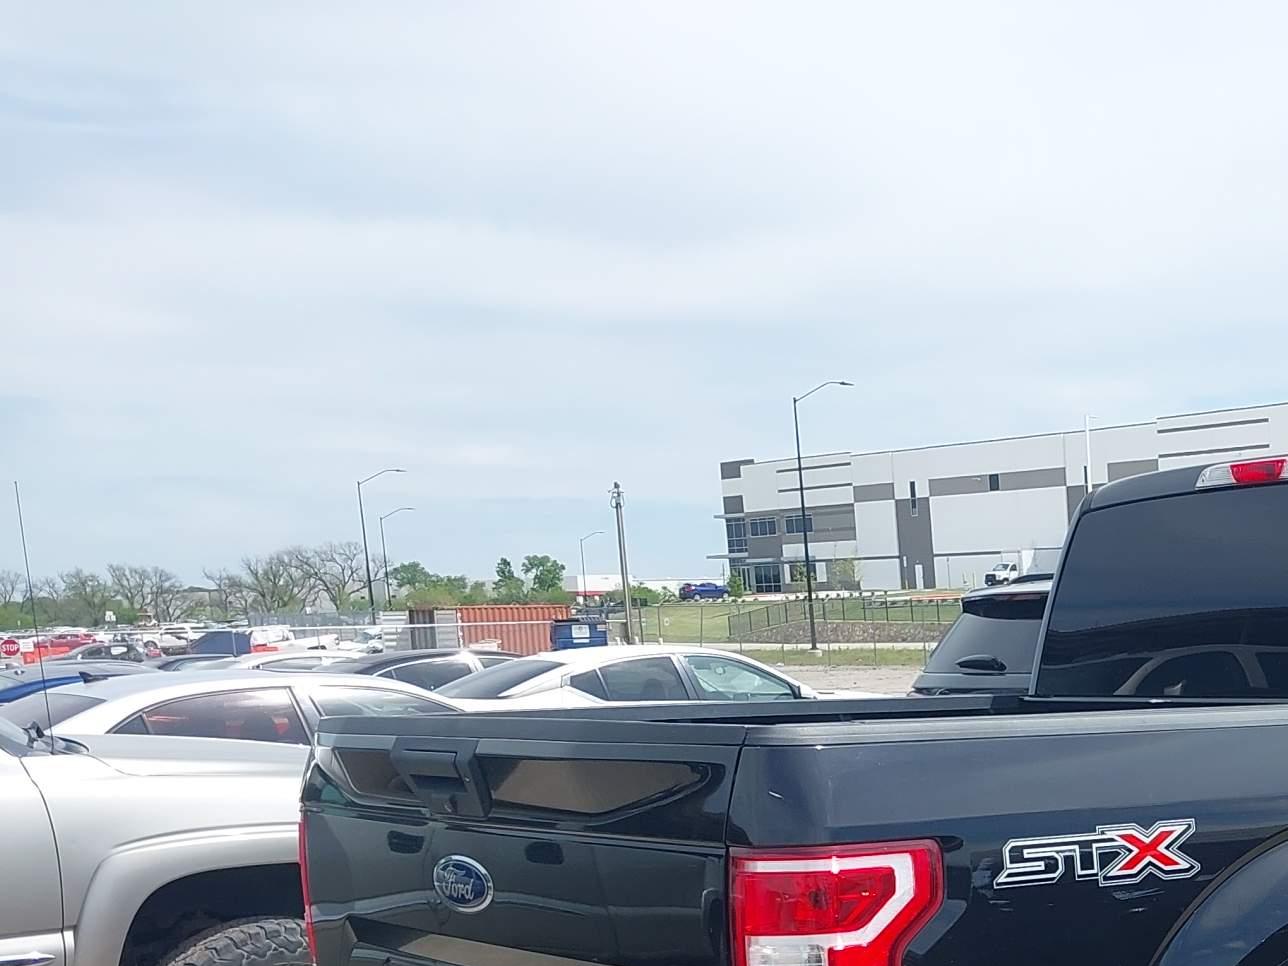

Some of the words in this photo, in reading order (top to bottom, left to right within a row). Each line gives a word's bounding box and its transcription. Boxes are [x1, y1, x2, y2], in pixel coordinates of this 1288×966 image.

[2, 644, 19, 653] STOP
[995, 819, 1199, 888] STX
[440, 865, 475, 900] Ford
